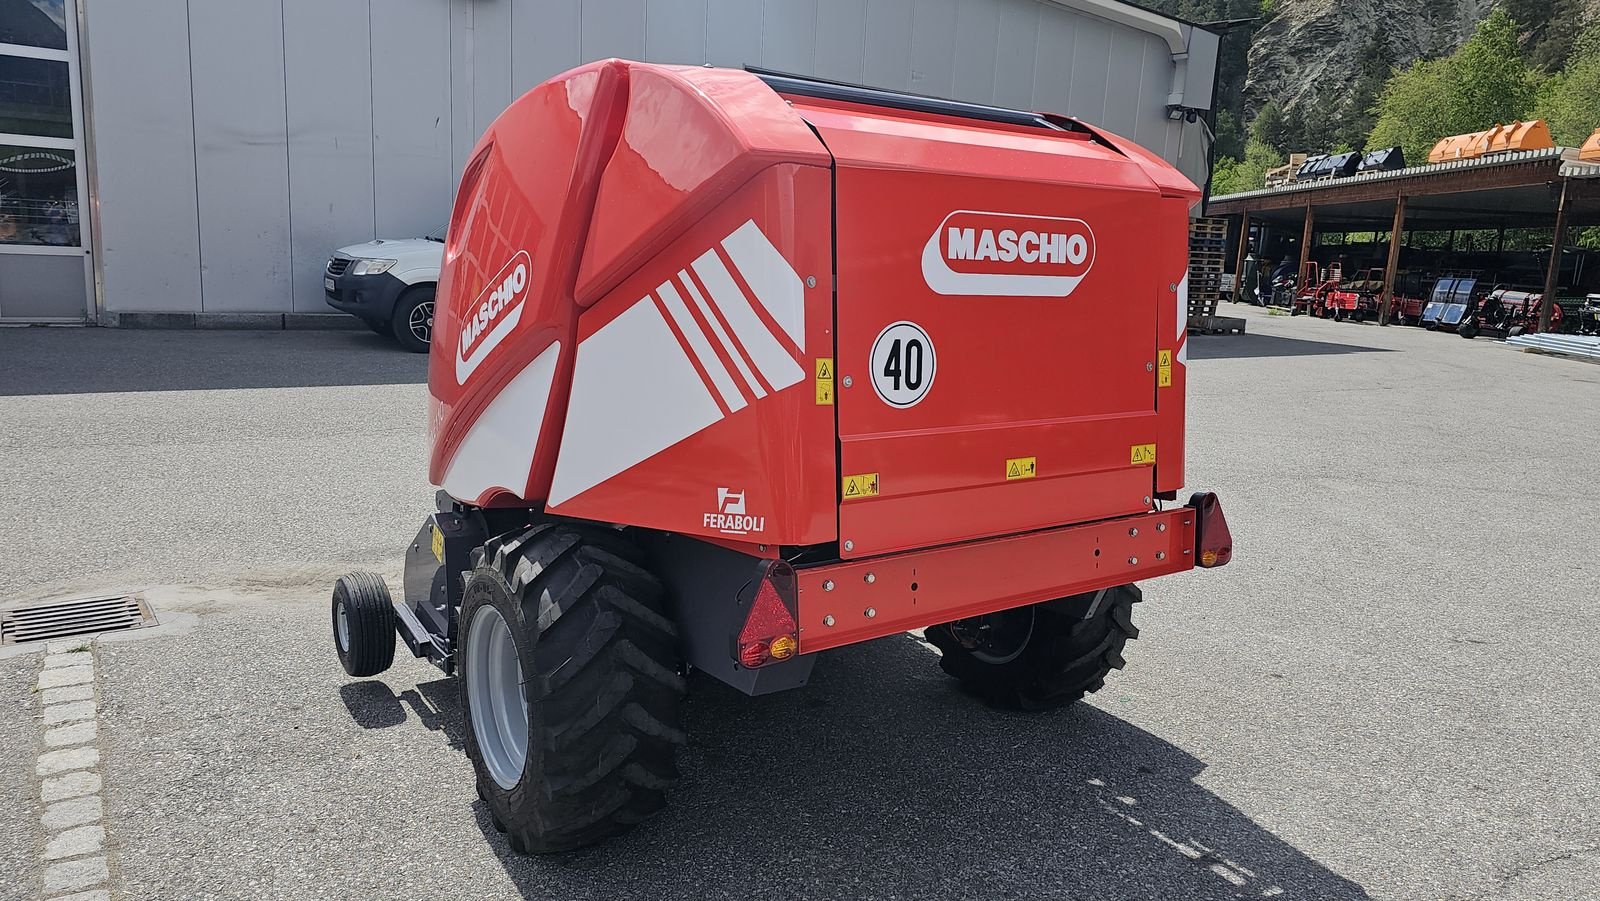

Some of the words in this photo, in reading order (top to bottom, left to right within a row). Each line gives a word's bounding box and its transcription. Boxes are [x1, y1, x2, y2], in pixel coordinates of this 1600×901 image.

[948, 227, 1088, 265] MASCHIO
[461, 263, 527, 355] MASCHIO
[884, 339, 923, 391] 40
[703, 513, 765, 532] FERABOLI
